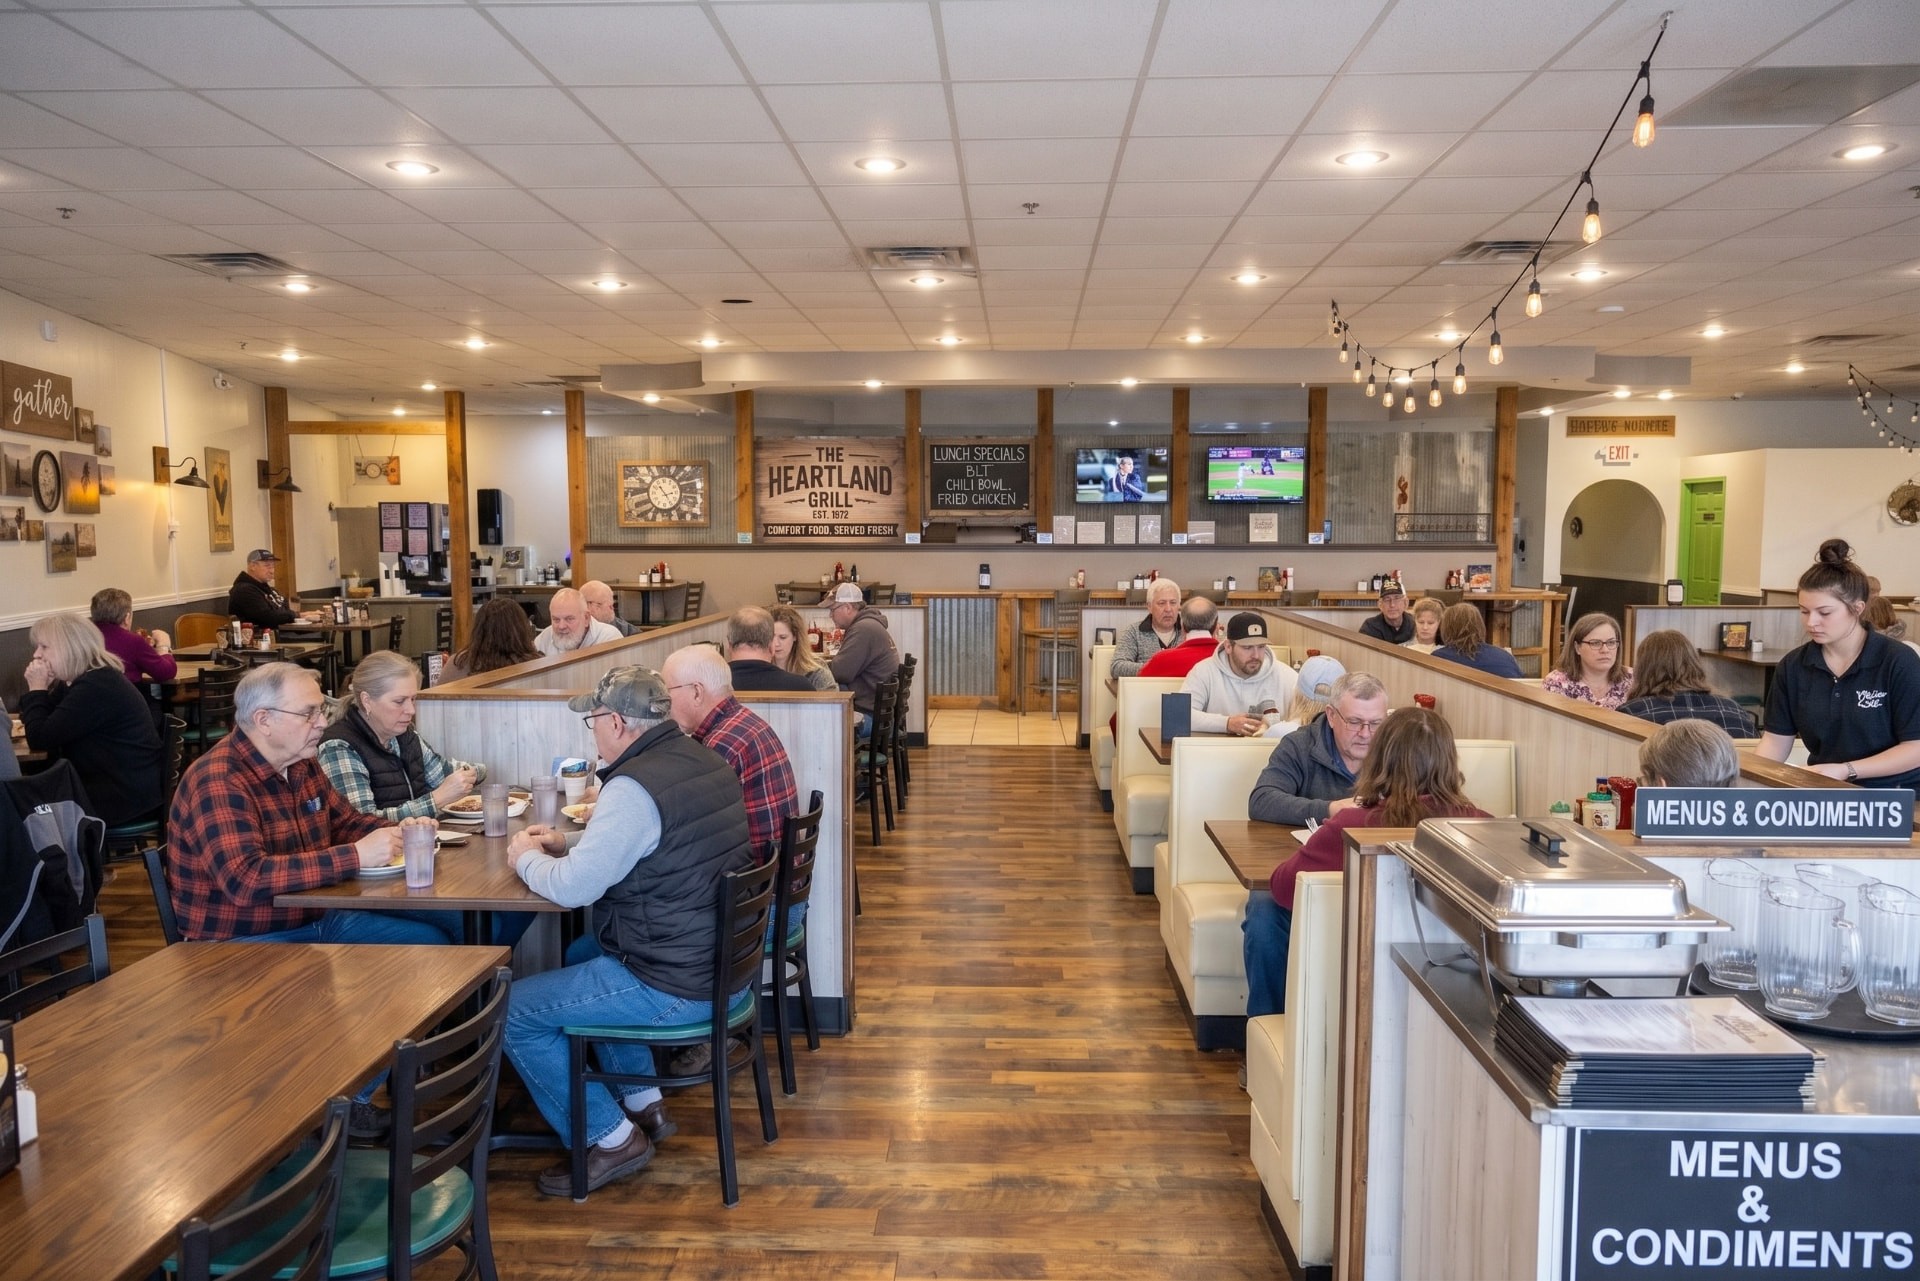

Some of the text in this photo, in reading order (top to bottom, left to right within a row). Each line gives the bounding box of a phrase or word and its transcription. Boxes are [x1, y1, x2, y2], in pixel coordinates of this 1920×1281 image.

[13, 378, 72, 425] gather
[815, 446, 845, 463] THE
[934, 446, 1025, 461] LUNCH SPECIALS
[1608, 445, 1631, 460] EXIT
[966, 464, 995, 477] BLT
[768, 464, 893, 499] HEARTLAND
[946, 478, 974, 491] CHILI
[807, 491, 854, 508] GRILL
[937, 492, 1016, 505] FRIED CHICKEN
[812, 510, 830, 520] EST.
[767, 525, 807, 535] COMFORT
[834, 525, 866, 535] SERVED
[867, 525, 894, 535] FRESH
[1646, 799, 1904, 829] MENUS & CONDIMENTS
[1669, 1140, 1843, 1180] MENUS
[1737, 1184, 1772, 1223] &
[1591, 1227, 1915, 1270] CONDIMENTS
